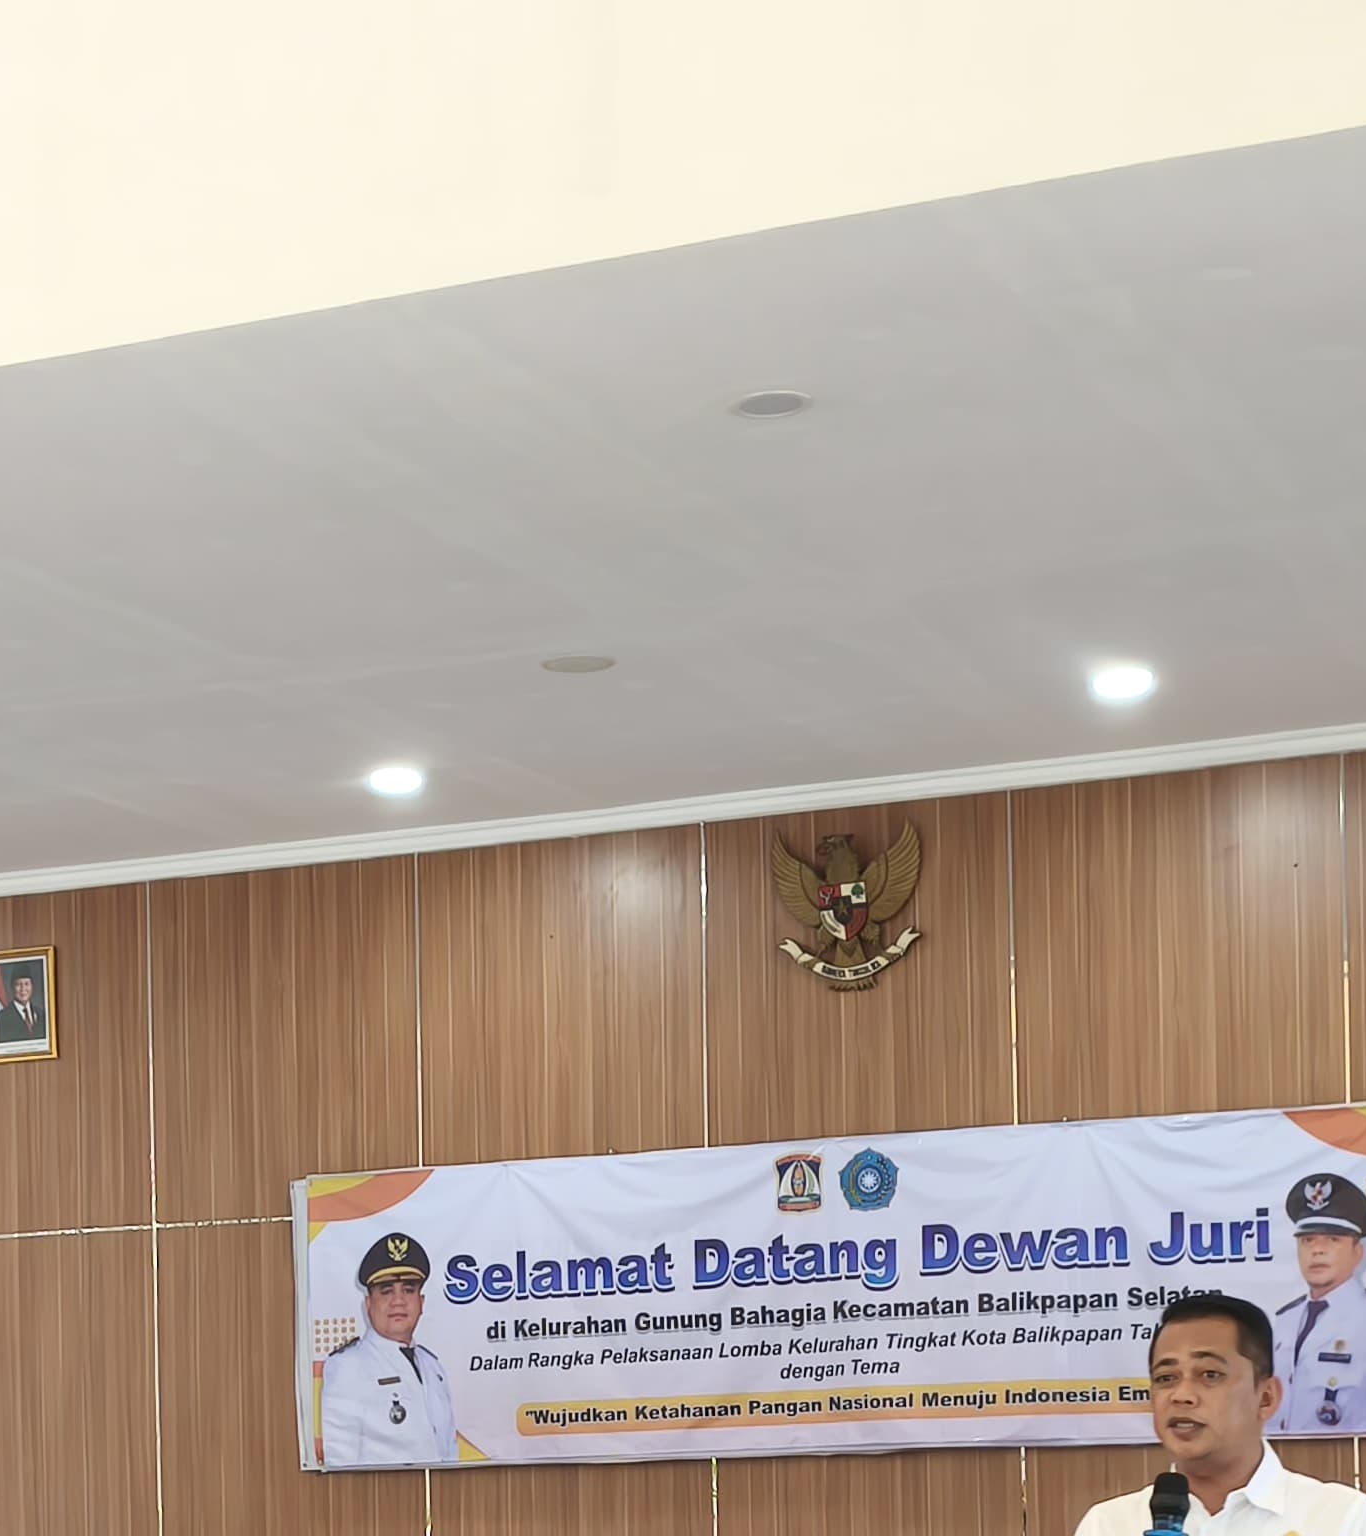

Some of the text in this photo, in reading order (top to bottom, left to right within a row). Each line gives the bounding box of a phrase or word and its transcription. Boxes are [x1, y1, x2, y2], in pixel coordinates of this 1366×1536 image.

[444, 1207, 1274, 1303] Selamat Datang Dewan Juri
[486, 1319, 506, 1340] di
[514, 1315, 627, 1339] Kelurahan
[635, 1310, 722, 1337] Gunung
[730, 1302, 826, 1330] Bahagia
[833, 1293, 969, 1321] Kecamatan
[977, 1288, 1118, 1316] Balikpapan
[470, 1352, 524, 1372] Dalam
[527, 1349, 594, 1373] Rangka
[600, 1343, 714, 1366] Pelaksanaan
[718, 1340, 783, 1360] Lomba
[788, 1334, 878, 1357] Kelurahan
[885, 1330, 957, 1353] Tingkat
[961, 1328, 1007, 1348] Kota
[1012, 1323, 1123, 1348] Balikpapan
[780, 1357, 900, 1382] dengan Tema
[525, 1384, 1151, 1429] "Wujudkan Ketahanan Pangan Nasional Menuju Indonesia Em
